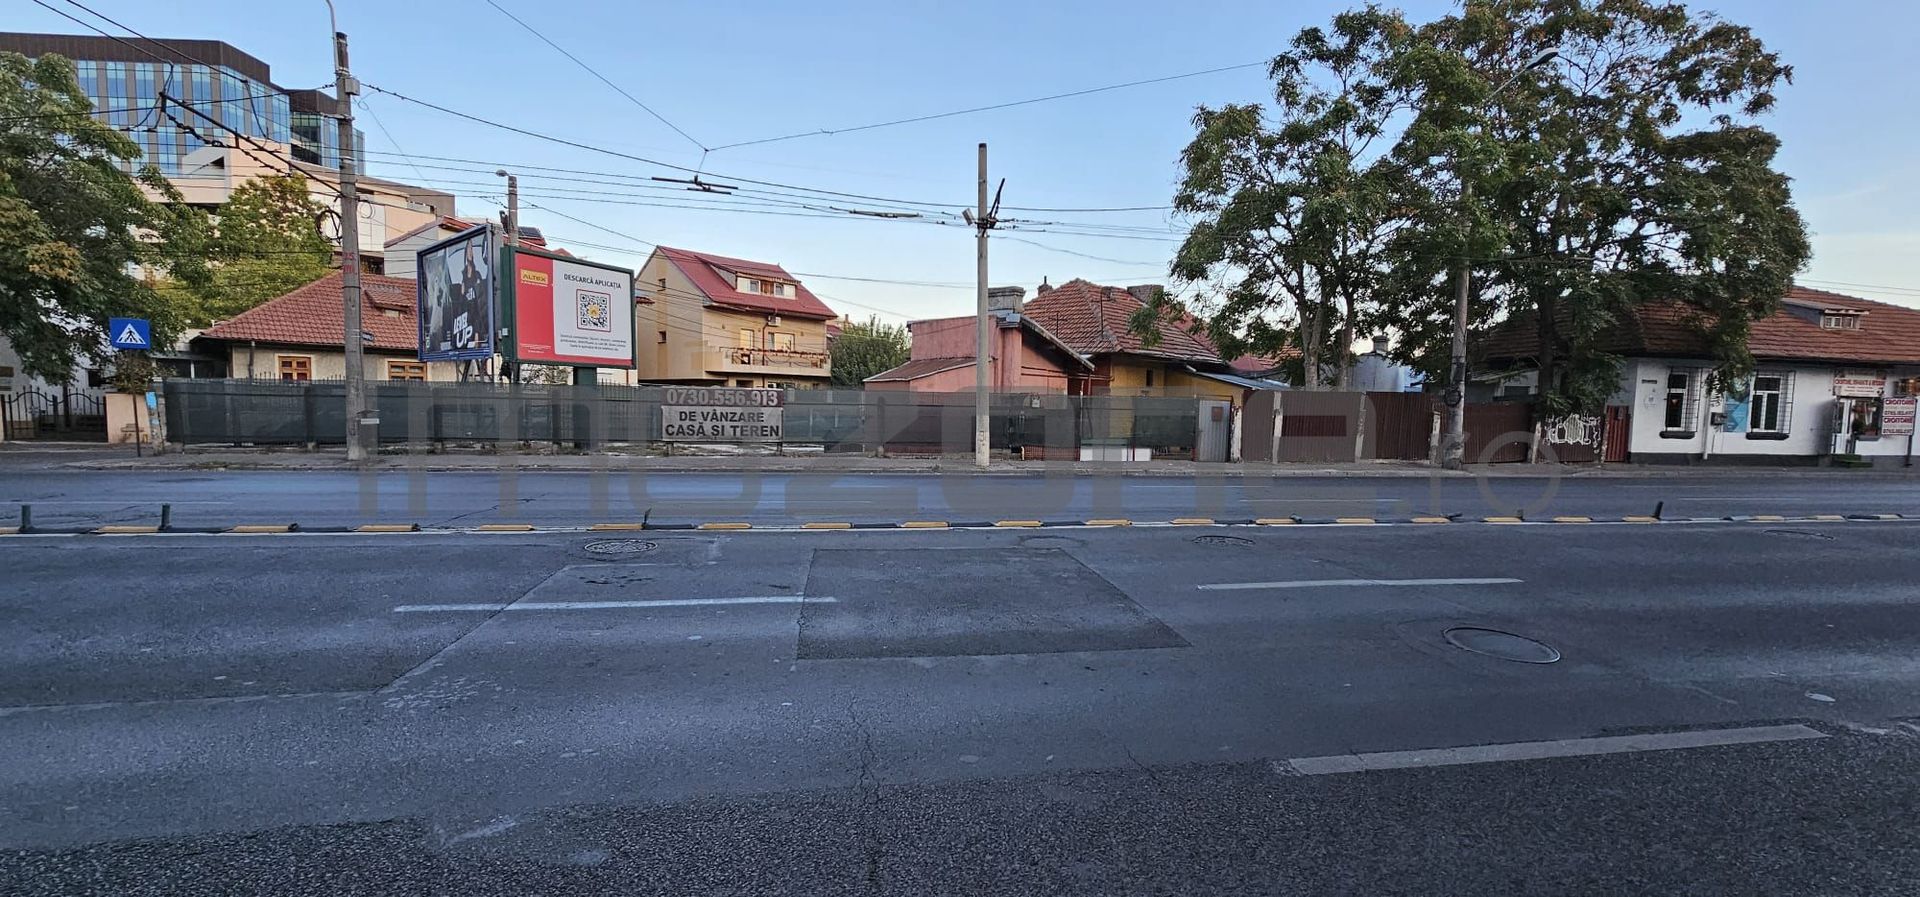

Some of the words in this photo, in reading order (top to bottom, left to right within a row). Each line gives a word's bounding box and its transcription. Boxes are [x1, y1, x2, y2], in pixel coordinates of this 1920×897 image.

[522, 274, 547, 283] ALTEX
[595, 279, 622, 289] APLICAȚIA
[453, 312, 468, 335] LEVEL
[456, 325, 473, 349] UP
[666, 388, 778, 406] 0730.556.913
[679, 411, 696, 422] DE
[700, 409, 765, 422] VÂNZARE
[665, 422, 706, 436] CASĂ
[730, 425, 780, 437] TEREN
